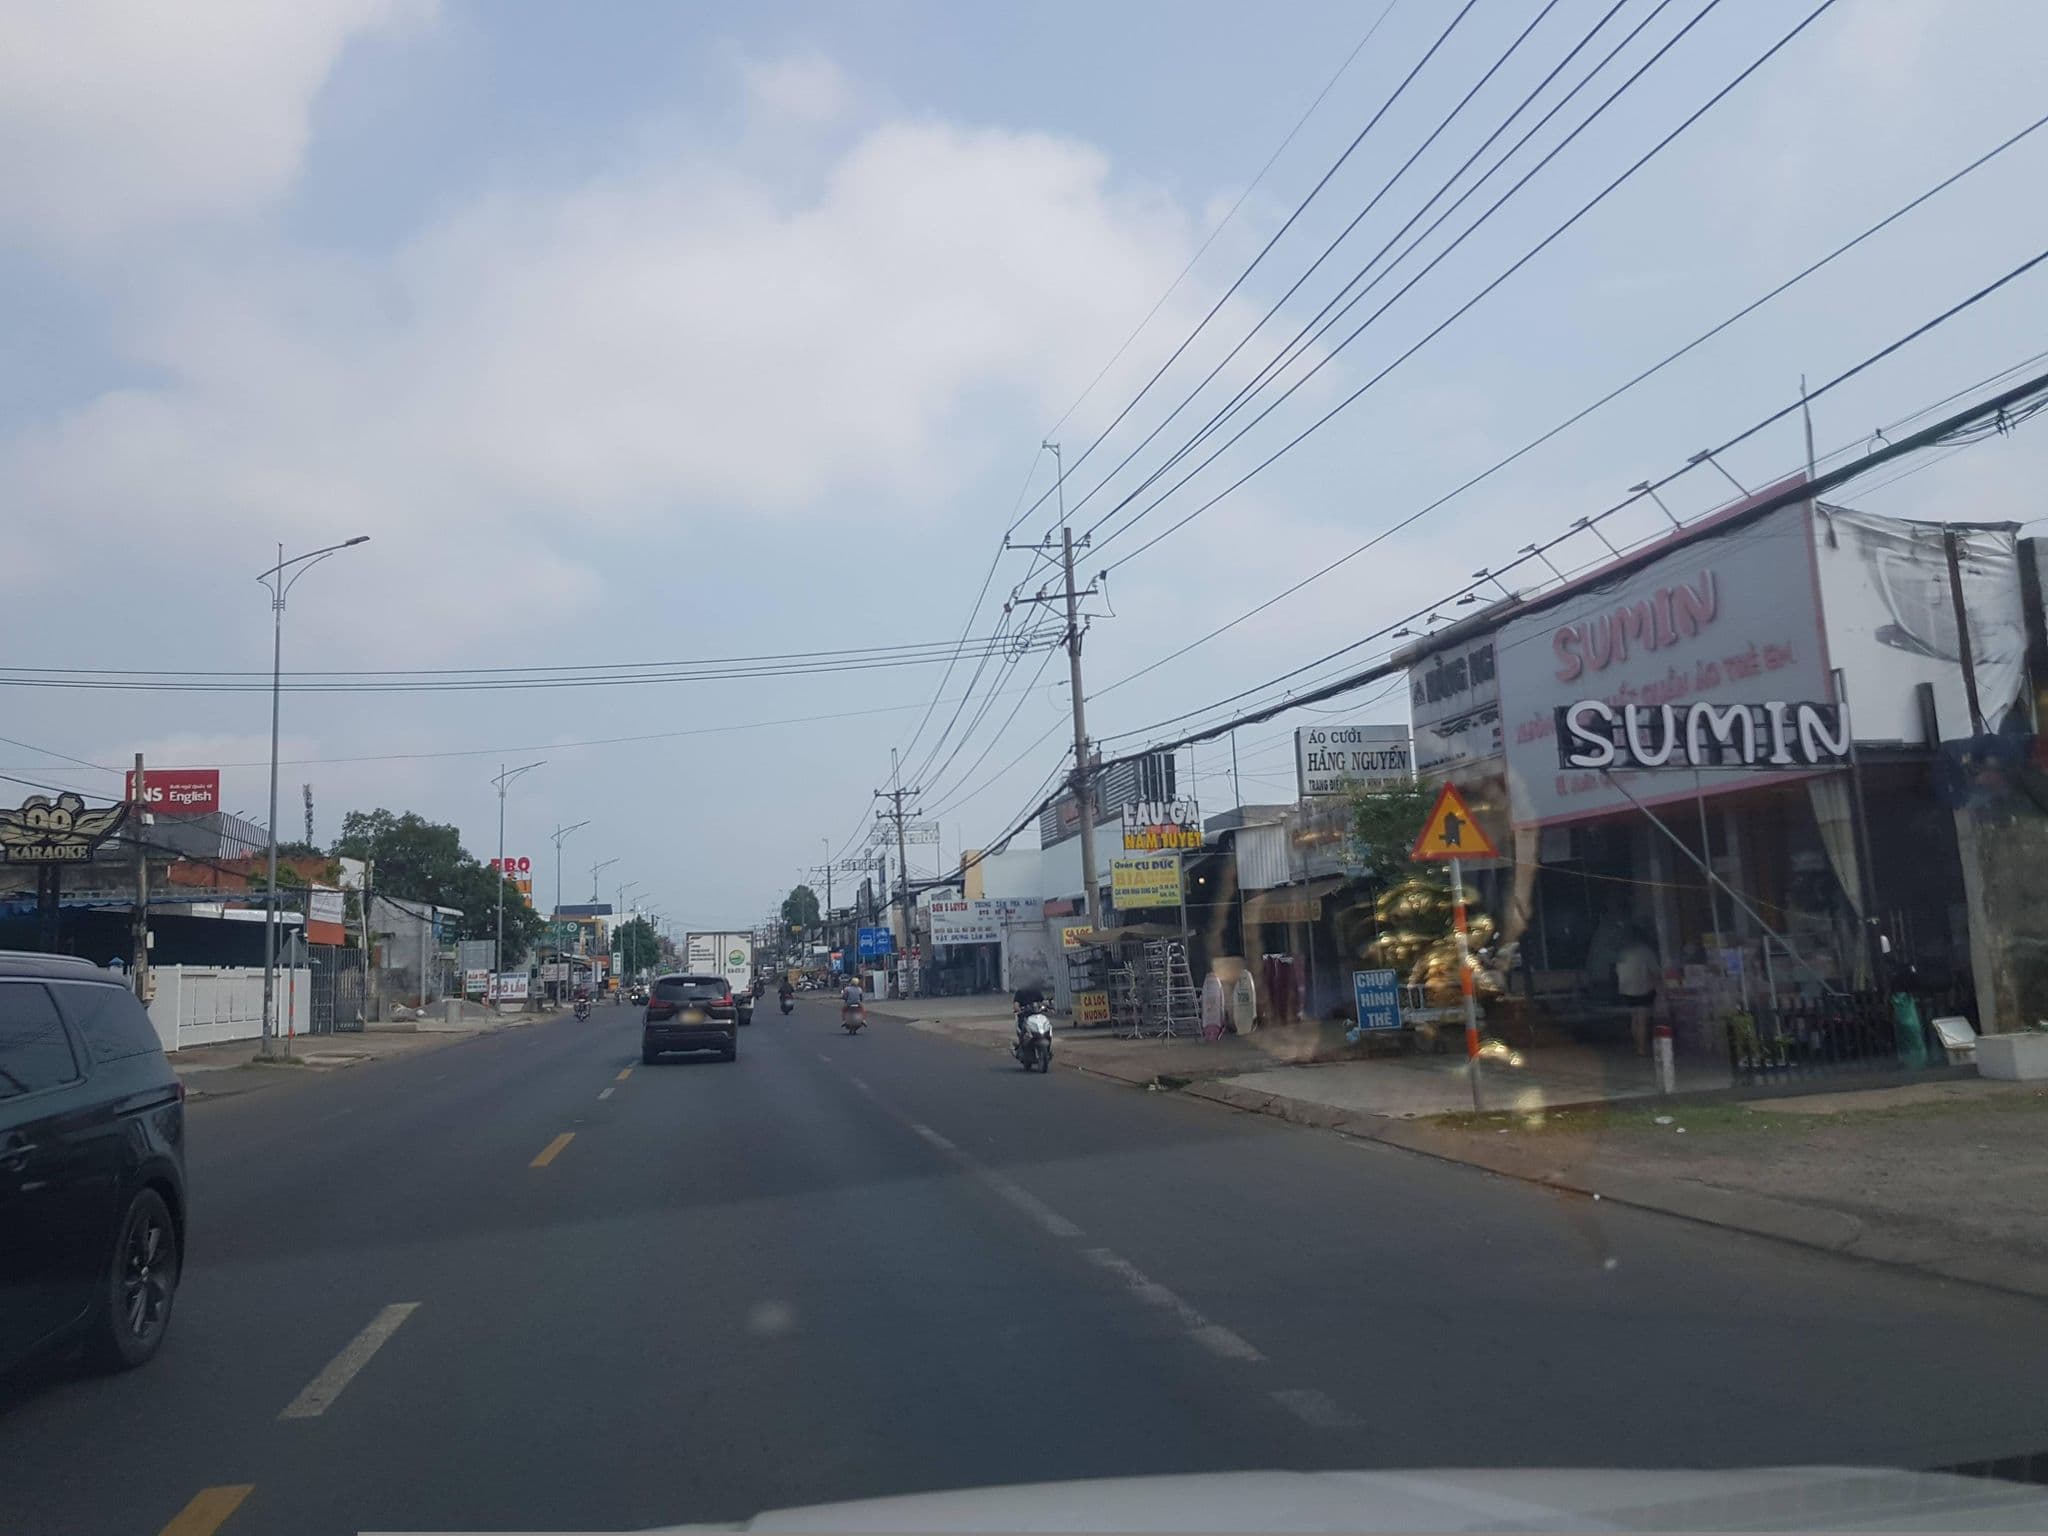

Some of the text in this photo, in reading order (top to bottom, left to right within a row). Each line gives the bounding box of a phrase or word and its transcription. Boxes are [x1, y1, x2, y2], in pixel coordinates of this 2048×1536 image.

[1552, 569, 1718, 683] SUMIN
[1308, 729, 1326, 744] ÁO
[1566, 699, 1850, 768] SUMIN
[169, 791, 212, 804] English
[1169, 794, 1200, 825] GÀ
[8, 845, 88, 860] KARAOKE
[1360, 990, 1395, 1007] HÌNH
[1367, 1006, 1393, 1027] THẺ
